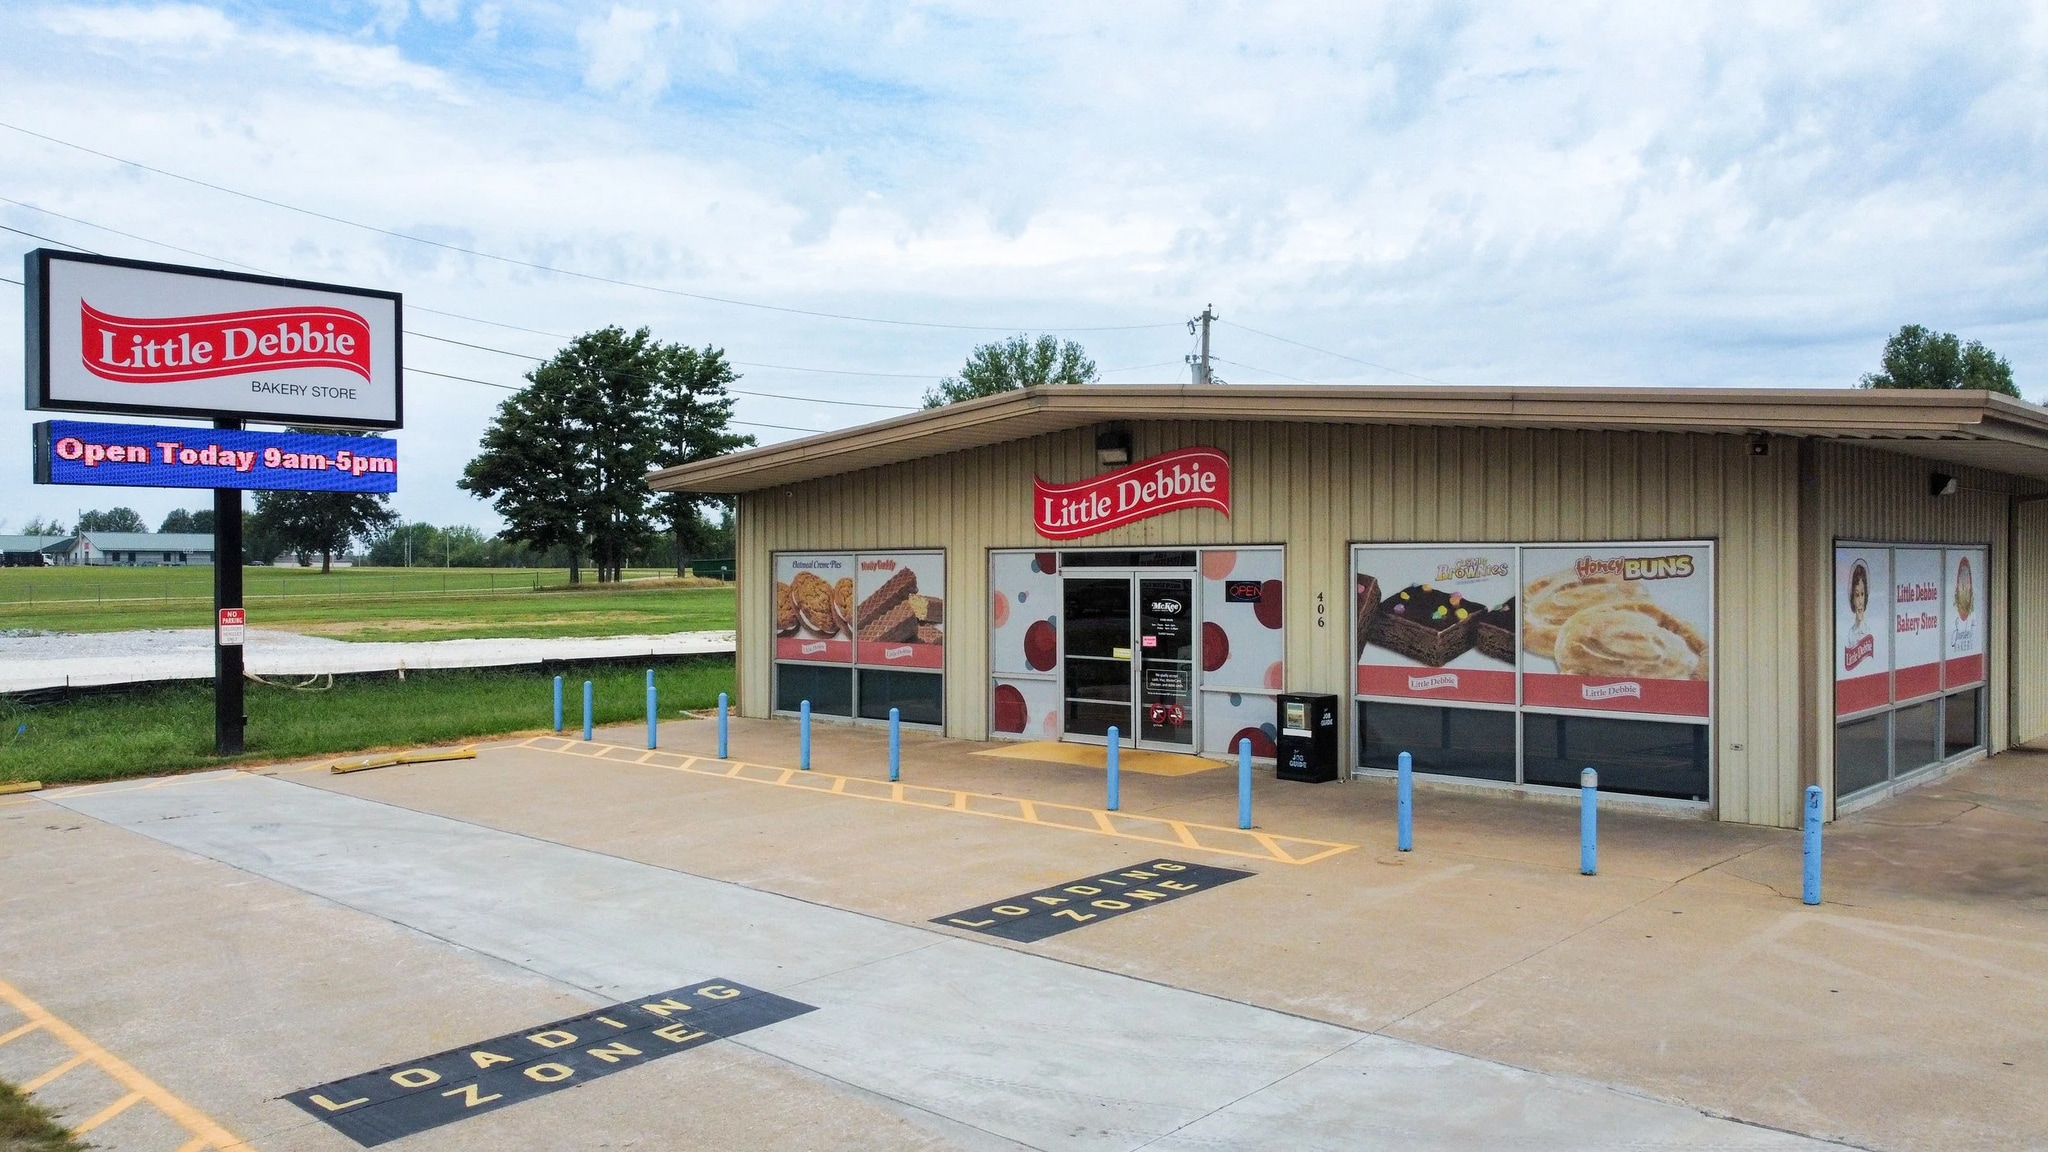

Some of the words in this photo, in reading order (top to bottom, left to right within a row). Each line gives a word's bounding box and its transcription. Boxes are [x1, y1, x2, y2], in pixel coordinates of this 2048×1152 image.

[99, 329, 213, 368] Little
[221, 322, 355, 361] Debbie
[252, 381, 307, 397] BAKERY
[311, 385, 357, 400] STORE
[56, 437, 150, 467] Open
[156, 441, 258, 473] Today
[263, 448, 397, 477] 9am-5pm
[1043, 491, 1112, 527] Little
[1117, 463, 1216, 513] Debbie
[829, 559, 842, 569] Pies
[1623, 555, 1694, 580] BUNS
[1229, 585, 1262, 597] OPEN
[1897, 583, 1915, 602] Little
[1915, 582, 1937, 601] Debbie
[1151, 602, 1179, 613] McKee
[1897, 612, 1920, 635] Bakery
[1920, 612, 1937, 629] Store
[1410, 680, 1430, 688] Little
[1430, 677, 1455, 687] Debbie
[1585, 688, 1607, 697] Little
[1608, 686, 1637, 695] Debbie
[1322, 712, 1331, 720] JOB
[1288, 760, 1308, 769] GUIDE
[948, 863, 1187, 928] LOADING
[1051, 880, 1198, 922] ZONE
[309, 985, 742, 1112] LOADING
[441, 1022, 706, 1108] ZONE
